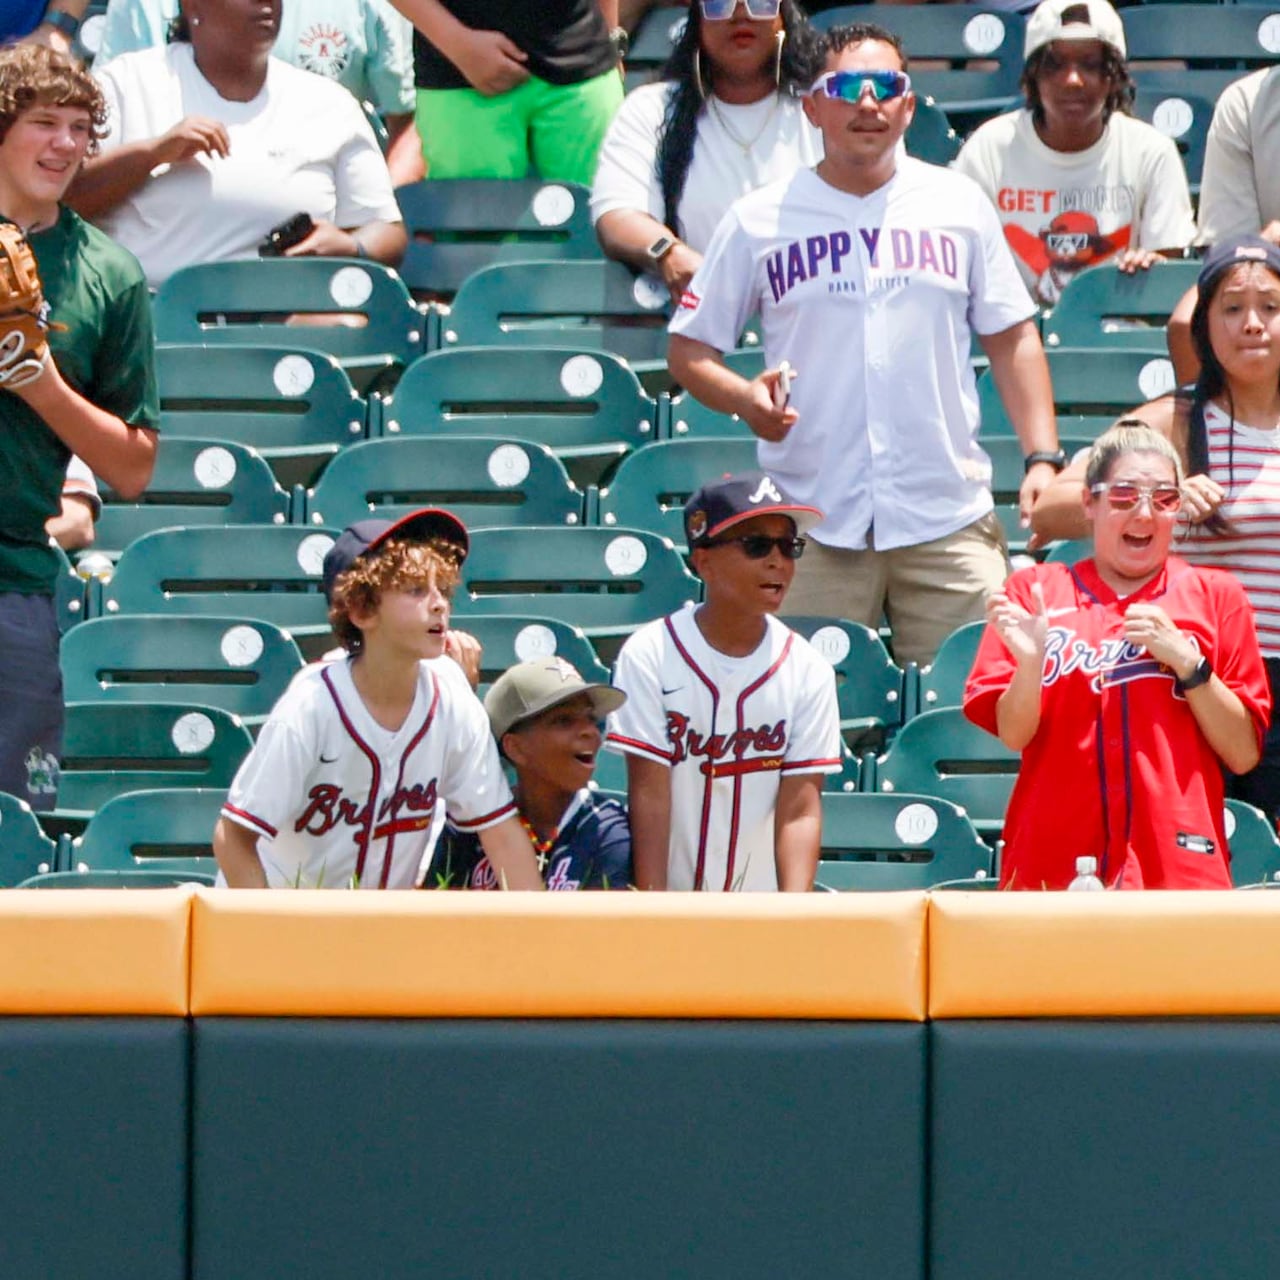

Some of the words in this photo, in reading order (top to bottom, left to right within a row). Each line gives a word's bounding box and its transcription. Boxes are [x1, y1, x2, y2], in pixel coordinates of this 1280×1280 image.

[978, 26, 994, 42] 10
[1166, 111, 1181, 128] 11
[997, 186, 1057, 213] GET
[766, 227, 880, 305] HAPPY
[890, 228, 958, 280] DAD
[1153, 372, 1167, 387] 11
[748, 475, 783, 504] A
[821, 639, 839, 655] 10
[665, 710, 788, 766] Braves
[908, 815, 927, 832] 10
